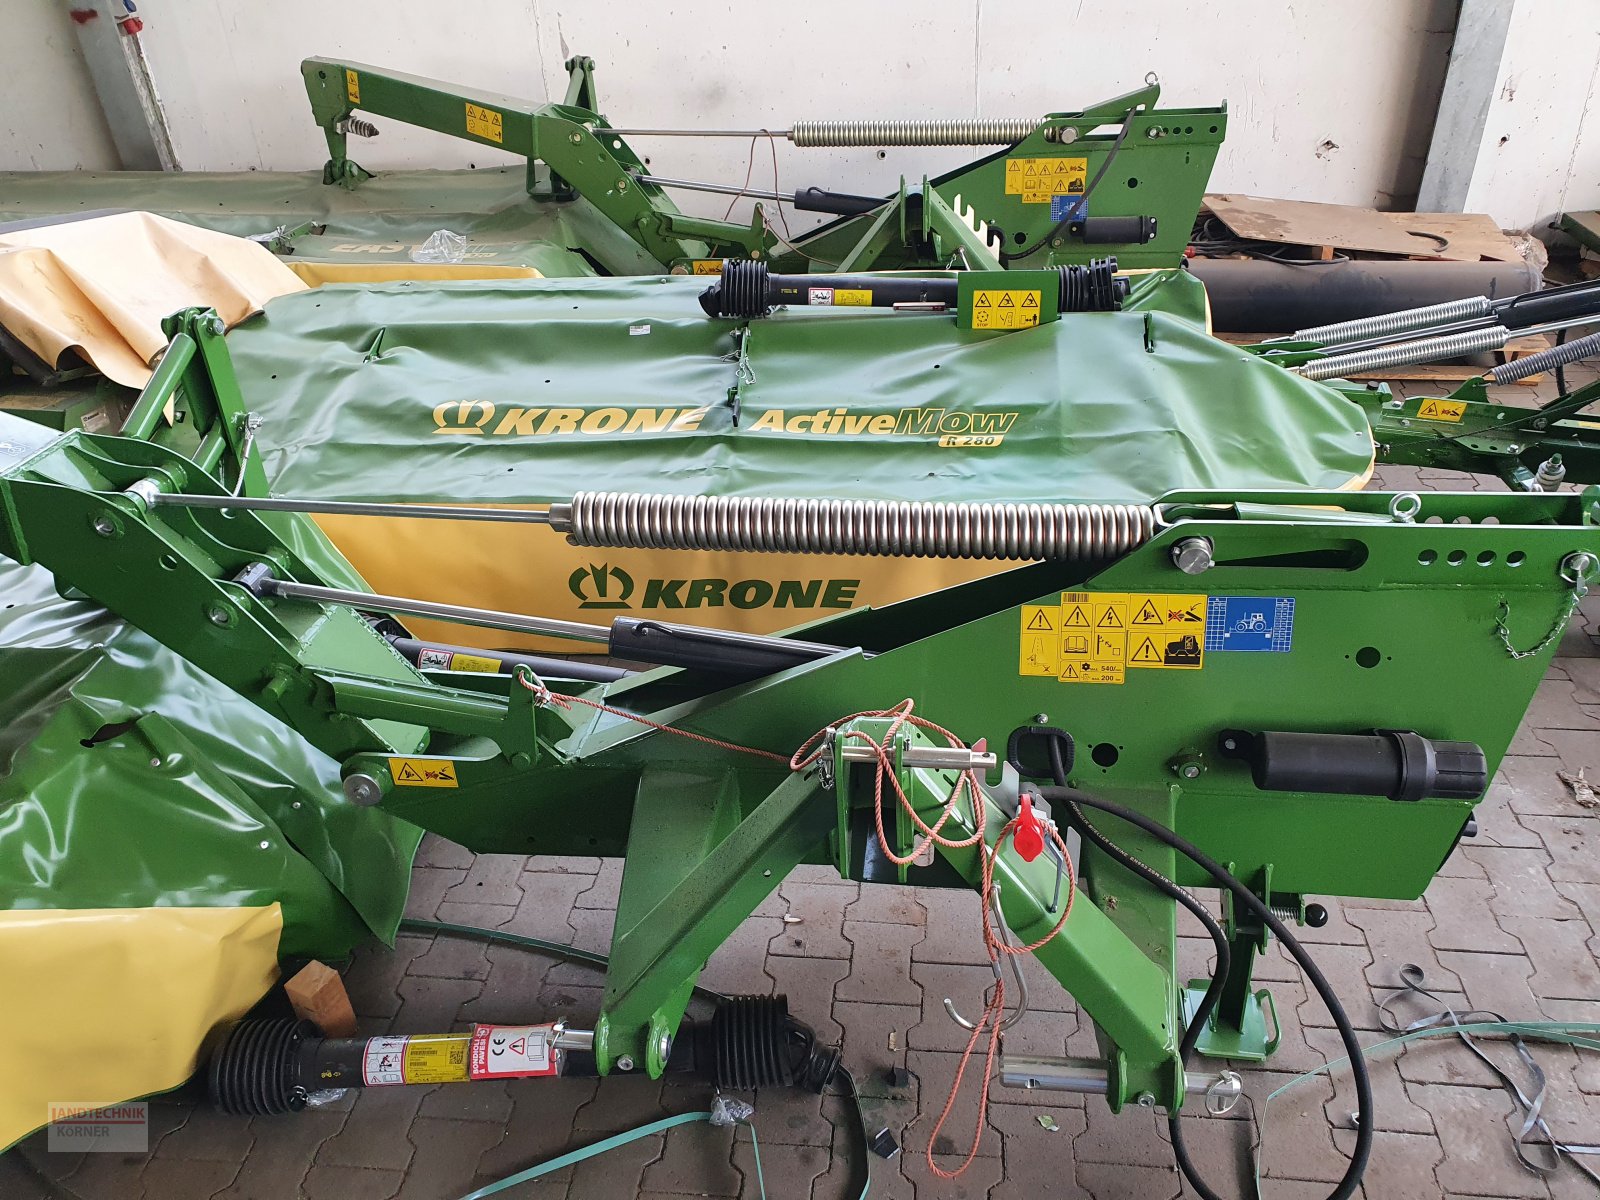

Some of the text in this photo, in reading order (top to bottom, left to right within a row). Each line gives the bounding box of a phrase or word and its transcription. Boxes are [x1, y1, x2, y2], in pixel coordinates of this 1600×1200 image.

[492, 407, 707, 435] KRONE
[748, 408, 1018, 434] ActiveMow
[946, 436, 995, 446] R 280
[641, 578, 861, 609] KRONE
[1172, 883, 1187, 895] DN10
